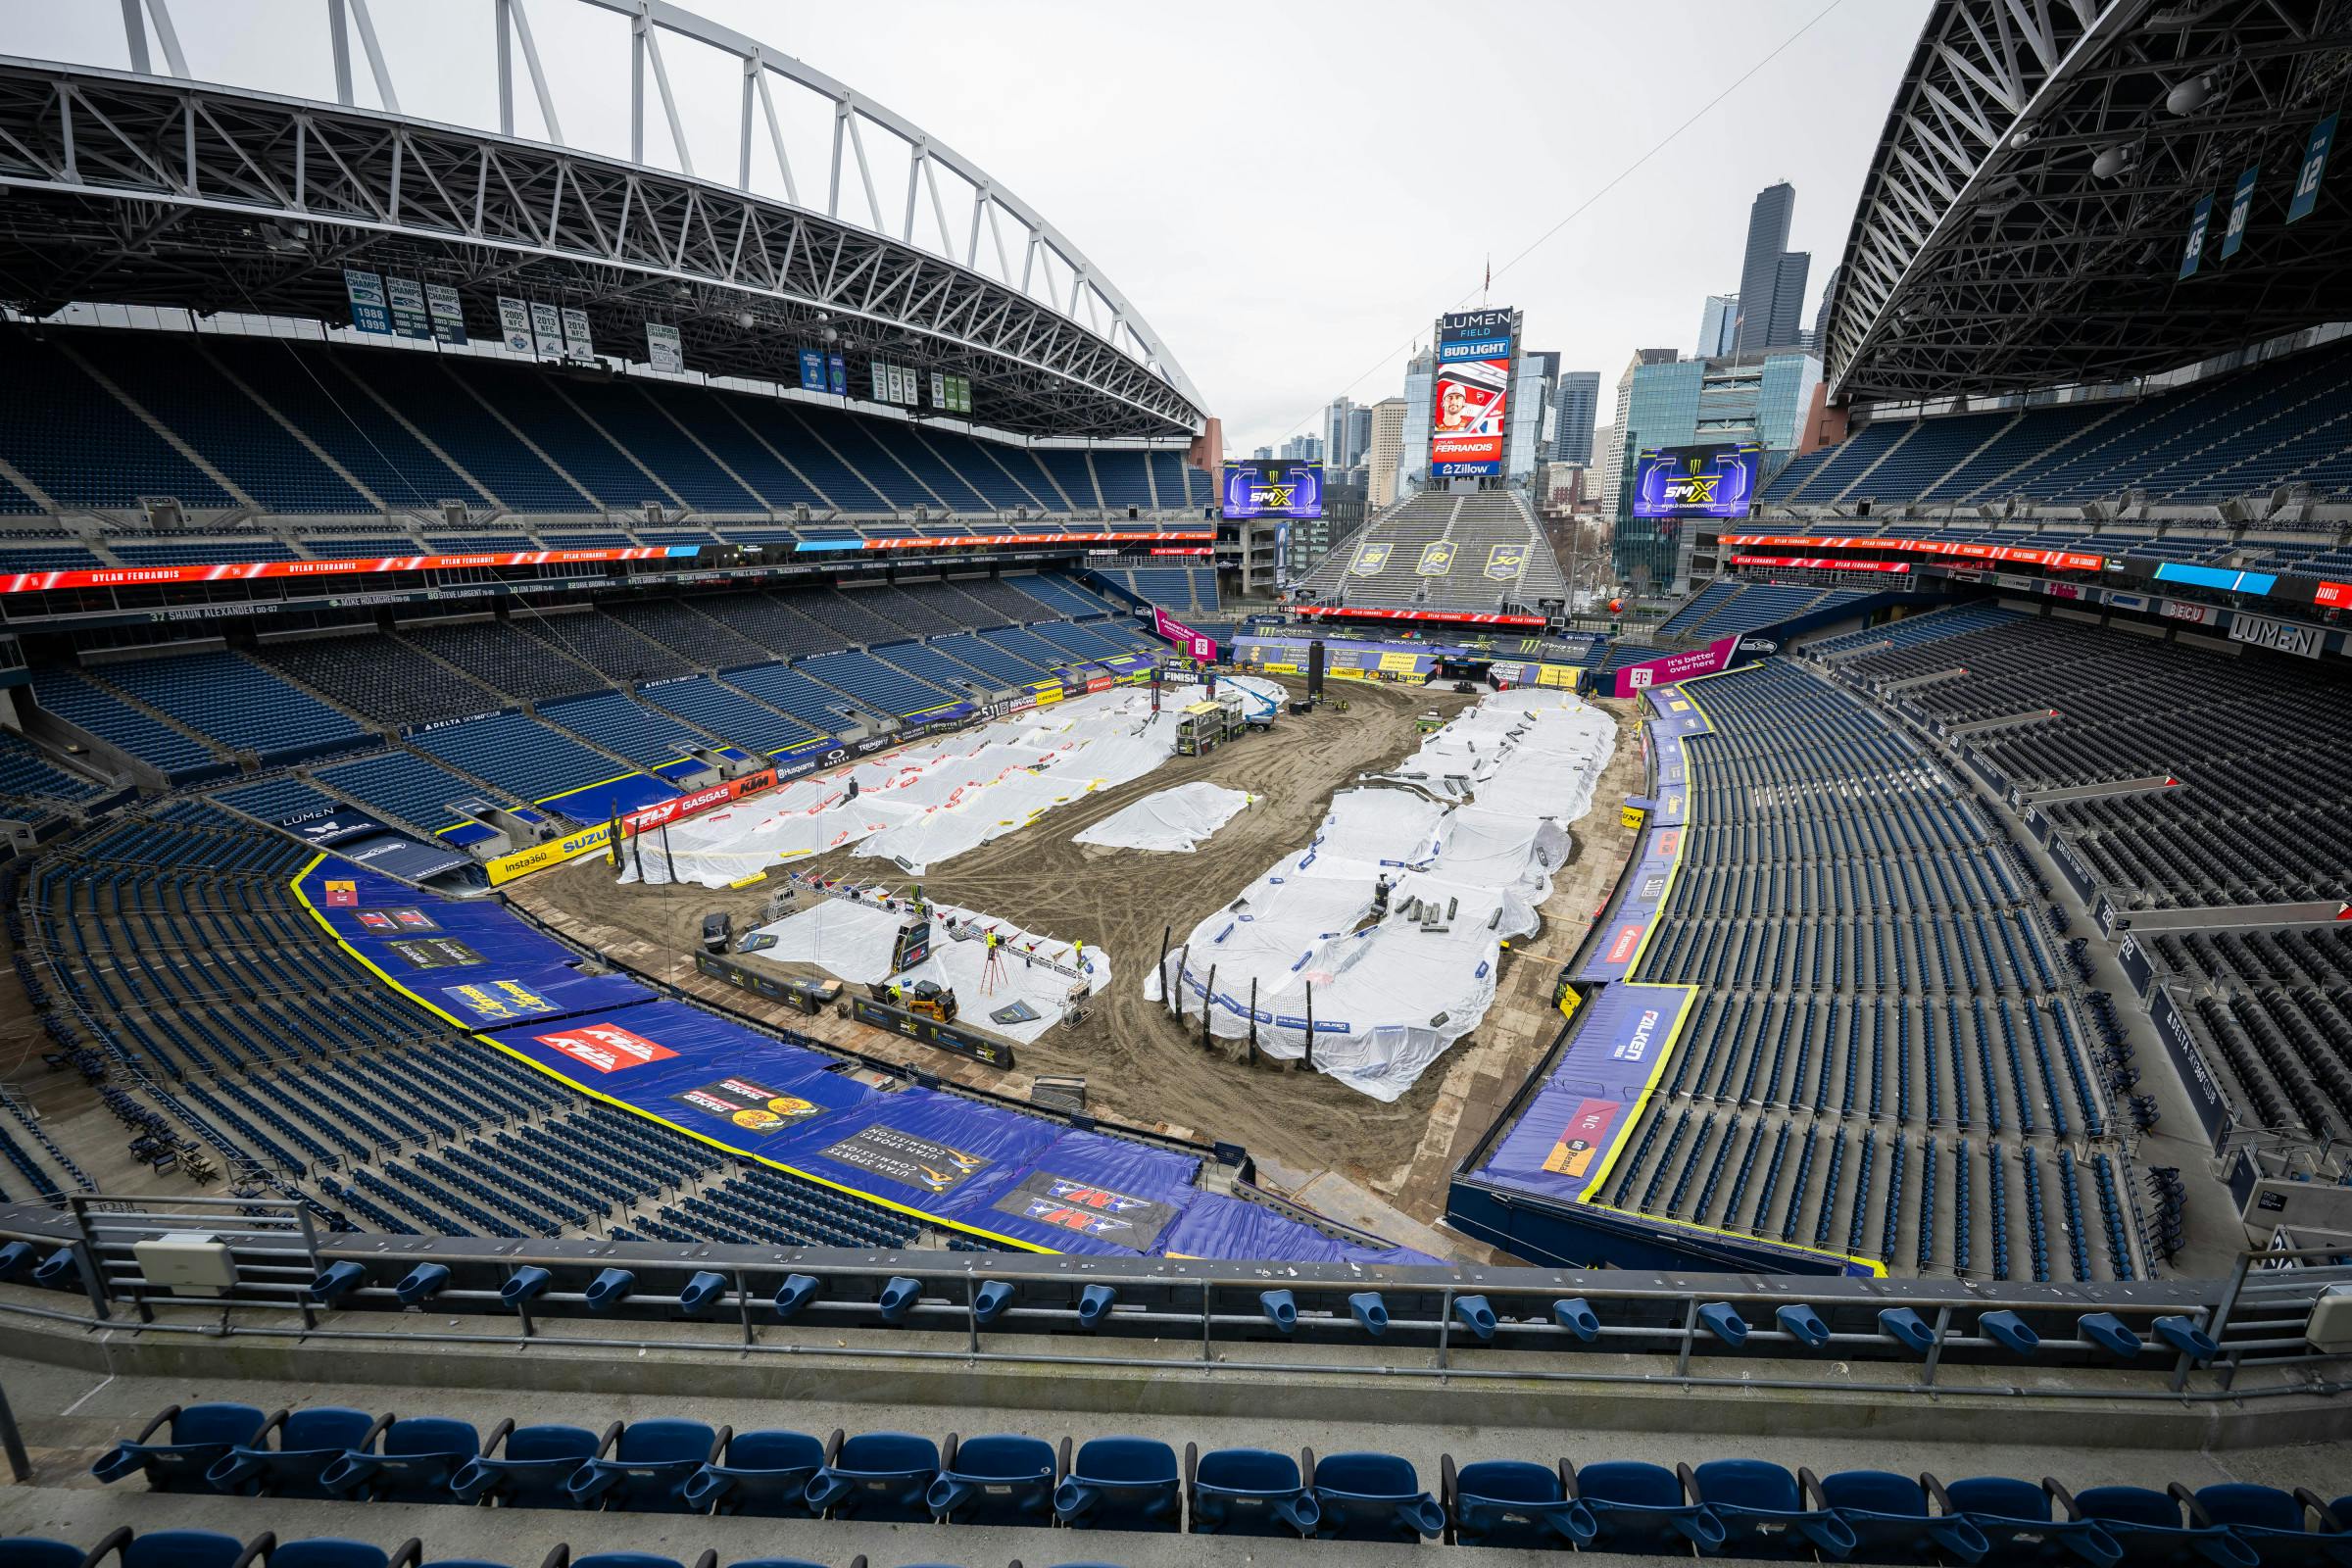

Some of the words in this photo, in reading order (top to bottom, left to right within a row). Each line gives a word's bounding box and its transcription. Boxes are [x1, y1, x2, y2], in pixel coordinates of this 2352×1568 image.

[2297, 155, 2323, 197] 12
[2228, 201, 2248, 237] 80
[2186, 227, 2205, 259] 45
[346, 278, 382, 291] CHAMPS
[360, 274, 380, 283] WEST
[389, 286, 421, 297] CHAMPS
[429, 293, 458, 303] CHAMPS
[358, 308, 384, 319] 1988
[504, 310, 524, 320] 2005
[360, 319, 386, 331] 1999
[537, 316, 556, 326] 2013
[567, 321, 586, 330] 2014
[1443, 312, 1511, 329] LUMEN
[503, 326, 531, 335] CHAMPIONS
[535, 331, 563, 340] CHAMPIONS
[648, 330, 679, 341] CHAMPIONS
[662, 327, 678, 335] WORLD
[1461, 328, 1490, 337] FIELD
[1444, 346, 1468, 357] BUD
[1470, 343, 1506, 354] LIGHT
[1435, 443, 1493, 452] FERRANDIS
[1454, 464, 1488, 474] Zillow
[1250, 488, 1294, 506] SMX
[1663, 481, 1718, 502] SMX
[441, 557, 460, 565] DYLAN
[462, 556, 495, 564] FERRANDIS
[1491, 556, 1521, 565] 30
[289, 564, 314, 573] DYLAN
[316, 562, 356, 571] FERRANDIS
[92, 573, 123, 582] DYLAN
[127, 570, 179, 581] FERRANDIS
[342, 597, 360, 607] MIKE
[361, 594, 395, 606] HOLMGREN
[439, 590, 457, 599] STEVE
[458, 589, 482, 598] LARGENT
[150, 612, 165, 622] 37
[169, 609, 201, 621] SHAUN
[204, 606, 255, 618] ALEXANDER
[2169, 604, 2201, 621] BECU
[1184, 628, 1195, 637] Best
[2233, 617, 2315, 656] LUMEN
[1169, 660, 1192, 670] SMX
[1668, 659, 1682, 667] It's
[1686, 652, 1715, 663] better
[1669, 664, 1691, 673] over
[1693, 660, 1715, 668] here
[1164, 672, 1198, 683] FINISH
[434, 718, 460, 728] DELTA
[858, 737, 889, 751] TRIUMPH
[825, 755, 850, 767] OAKLEY
[784, 760, 815, 776] Husqvarna
[739, 776, 769, 794] KTM
[682, 788, 729, 811] GASGAS
[284, 807, 334, 826] LUMEN
[625, 804, 676, 827] FLY
[505, 852, 547, 873] Insta360
[2102, 904, 2114, 928] 212
[2121, 934, 2134, 961] 212
[1625, 1010, 1659, 1060] FALKEN
[2171, 1017, 2190, 1055] DELTA
[2203, 1078, 2217, 1105] CLUB
[720, 1082, 765, 1100] TRACKER
[683, 1094, 729, 1112] TRACKER
[860, 1133, 905, 1150] SPORTS
[869, 1128, 946, 1155] COMMISSION
[827, 1148, 874, 1166] SPORTS
[837, 1144, 918, 1172] COMMISSION
[906, 1147, 938, 1160] UTAH
[876, 1164, 909, 1177] UTAH
